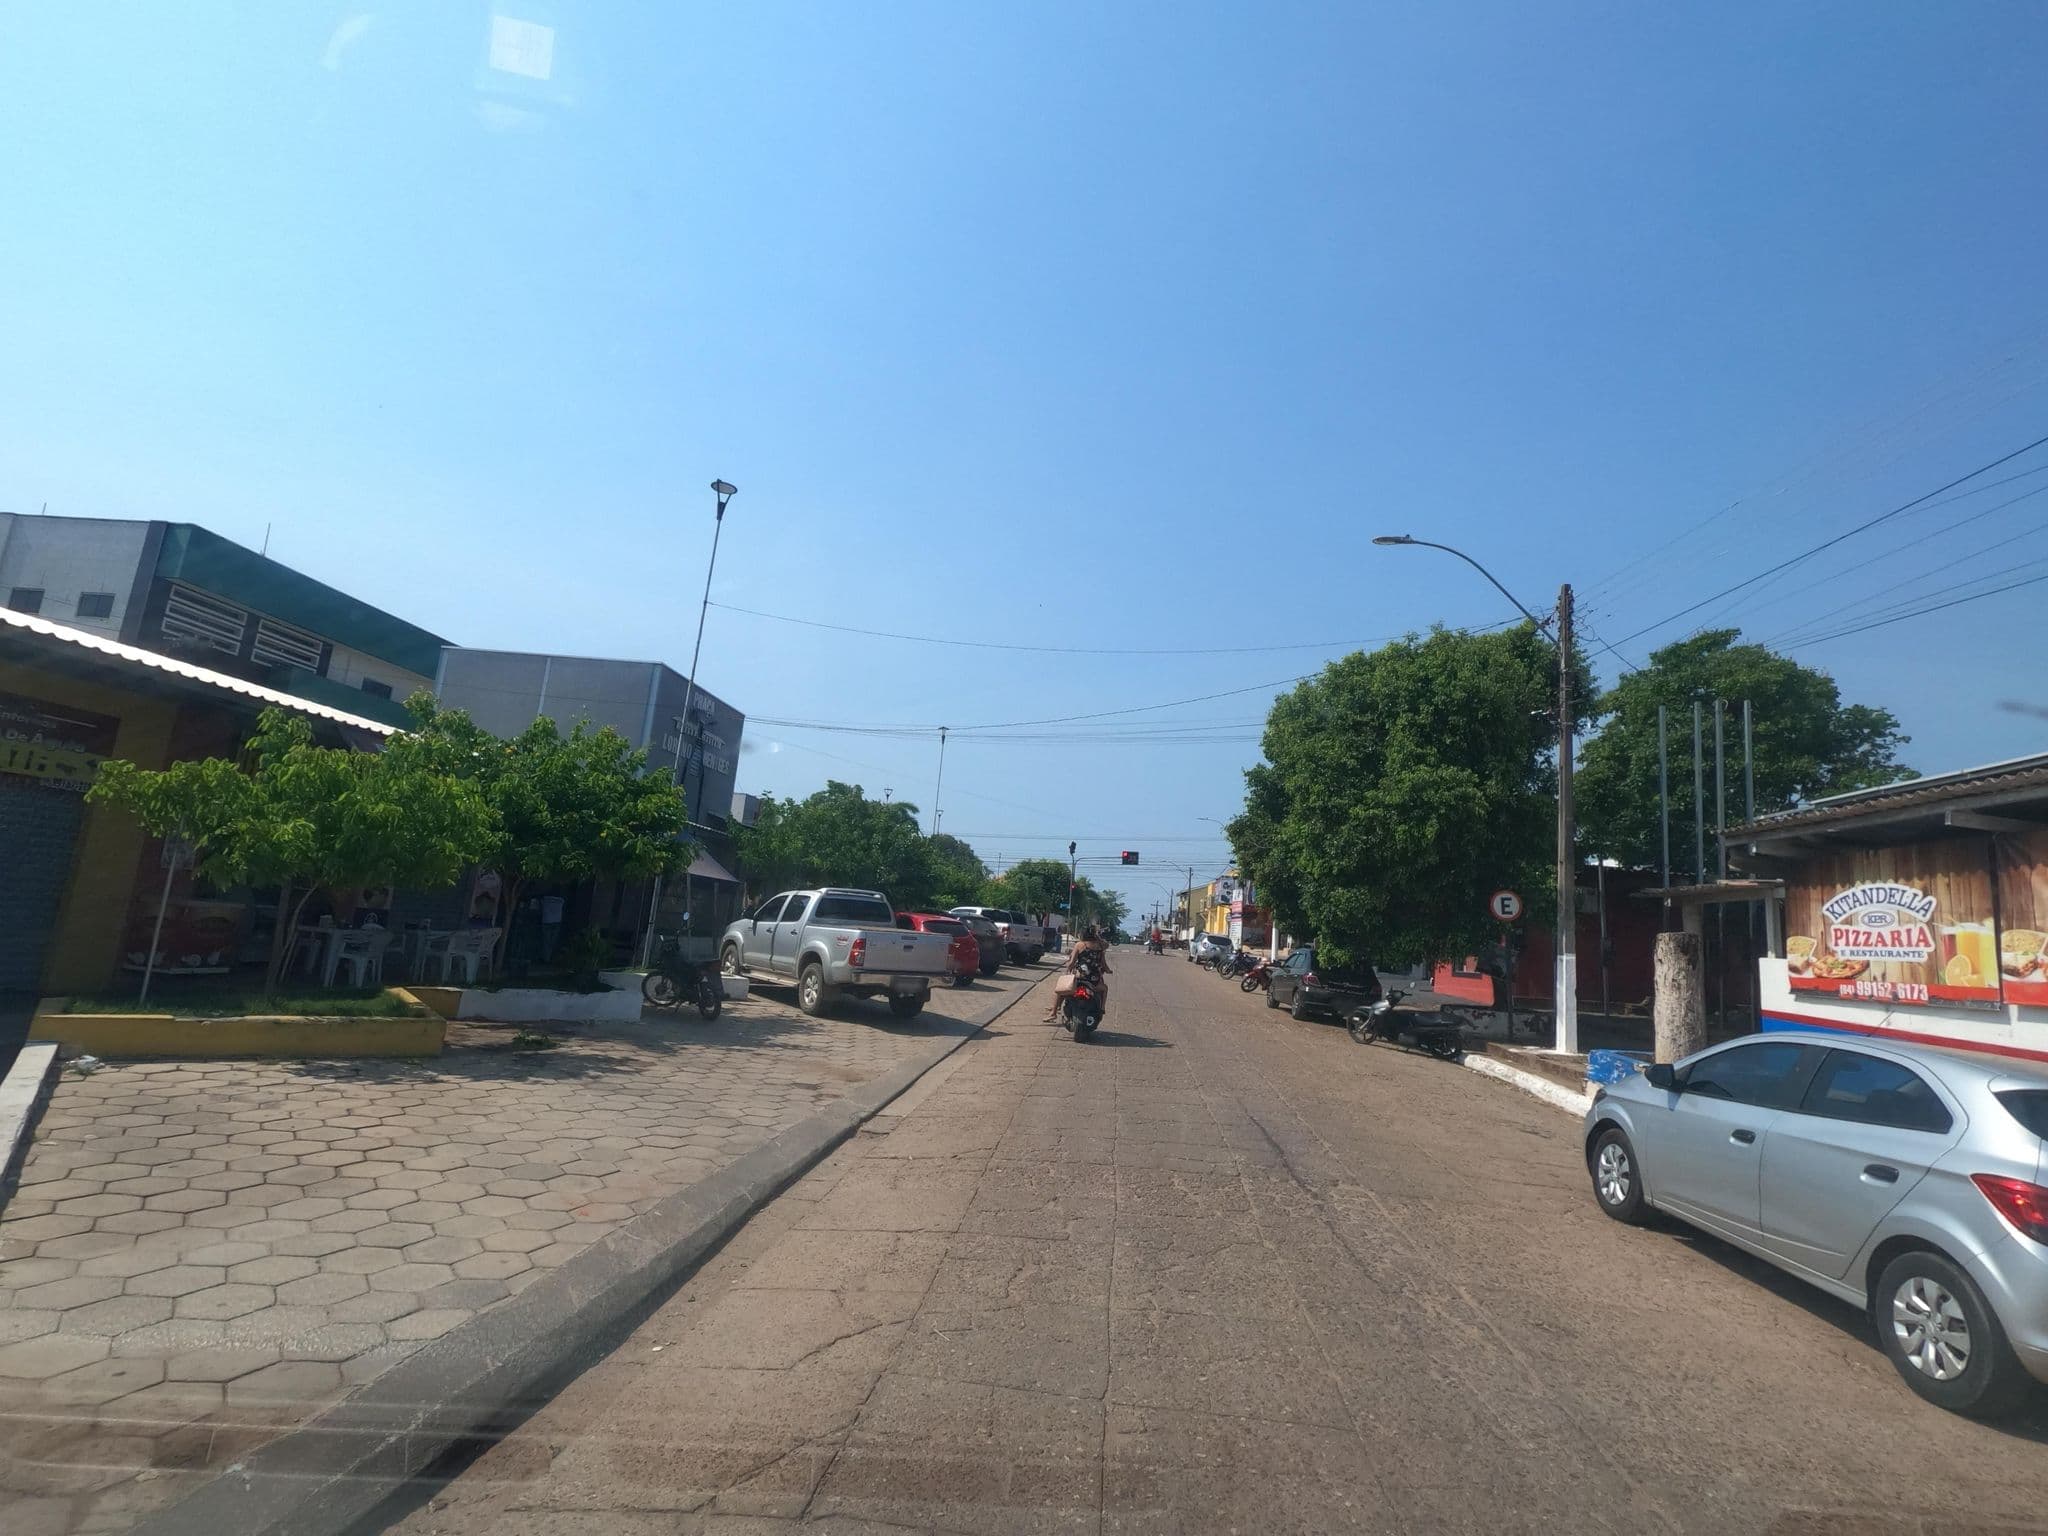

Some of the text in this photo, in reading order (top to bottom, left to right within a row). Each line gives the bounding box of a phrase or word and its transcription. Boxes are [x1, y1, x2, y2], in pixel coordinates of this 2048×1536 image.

[662, 733, 693, 759] LORNO
[1501, 896, 1513, 915] E
[1825, 886, 1933, 920] KITANDELLA
[1833, 926, 1932, 948] PIZZARIA
[1841, 949, 1924, 959] E RESTAURANTE
